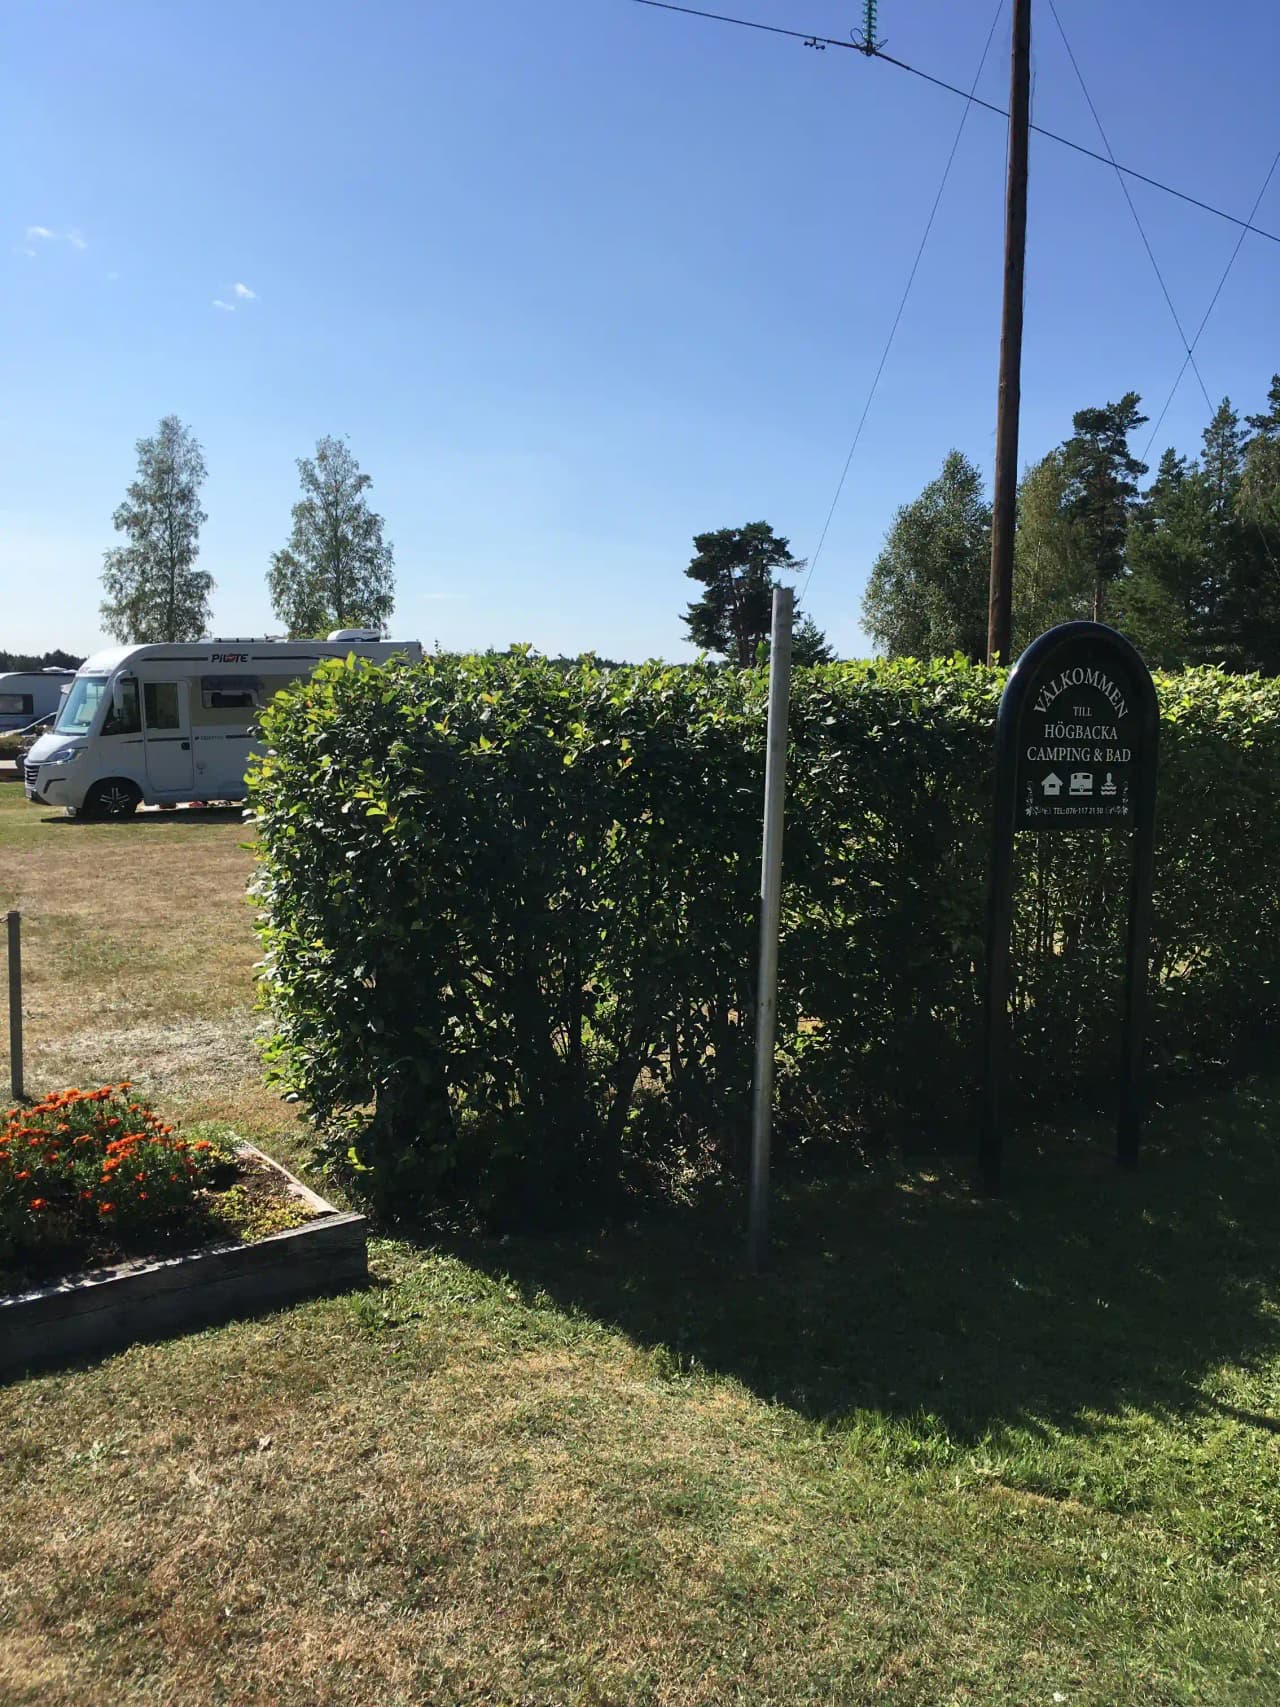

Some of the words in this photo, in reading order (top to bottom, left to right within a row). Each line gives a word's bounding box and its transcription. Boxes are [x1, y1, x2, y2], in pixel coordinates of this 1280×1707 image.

[1033, 667, 1128, 719] VÄLKOMMEN
[1072, 706, 1093, 717] TILL
[1044, 721, 1118, 740] HÖGBACKA
[1027, 746, 1091, 761] CAMPING
[1093, 748, 1103, 762] &
[1106, 748, 1131, 762] BAD
